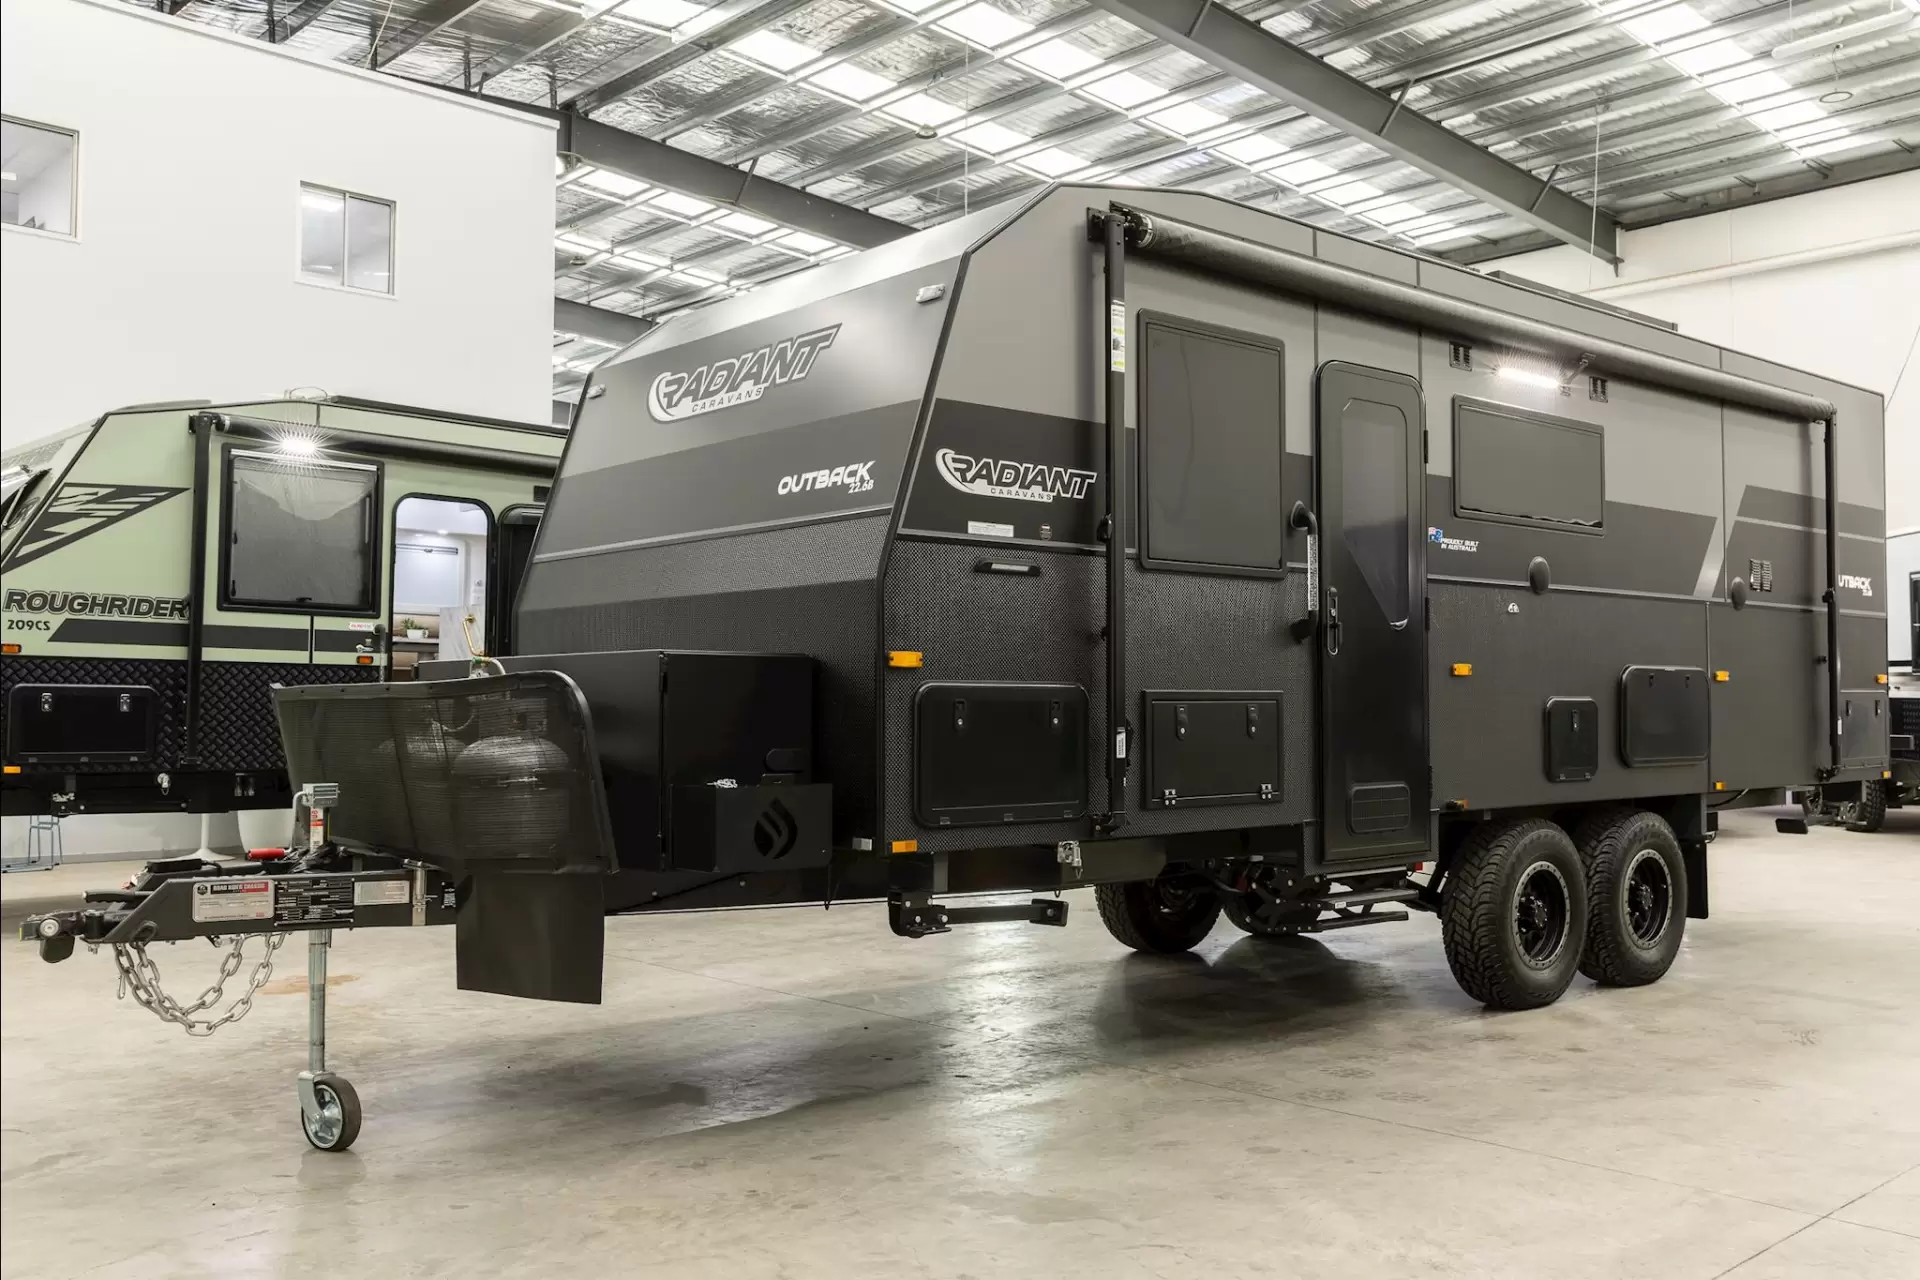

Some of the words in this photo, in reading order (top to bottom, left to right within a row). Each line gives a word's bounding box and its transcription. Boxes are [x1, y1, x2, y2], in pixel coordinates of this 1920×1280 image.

[649, 323, 842, 415] RADIANT
[691, 387, 763, 412] CARAVANS
[778, 460, 876, 495] OUTBACK
[938, 449, 1097, 499] RADIANT
[990, 487, 1052, 501] CARAVANS
[1448, 544, 1477, 552] AUSTRALIA
[1838, 574, 1872, 590] UTBACK
[3, 589, 190, 620] ROUGHRIDER
[7, 619, 51, 631] 209CS
